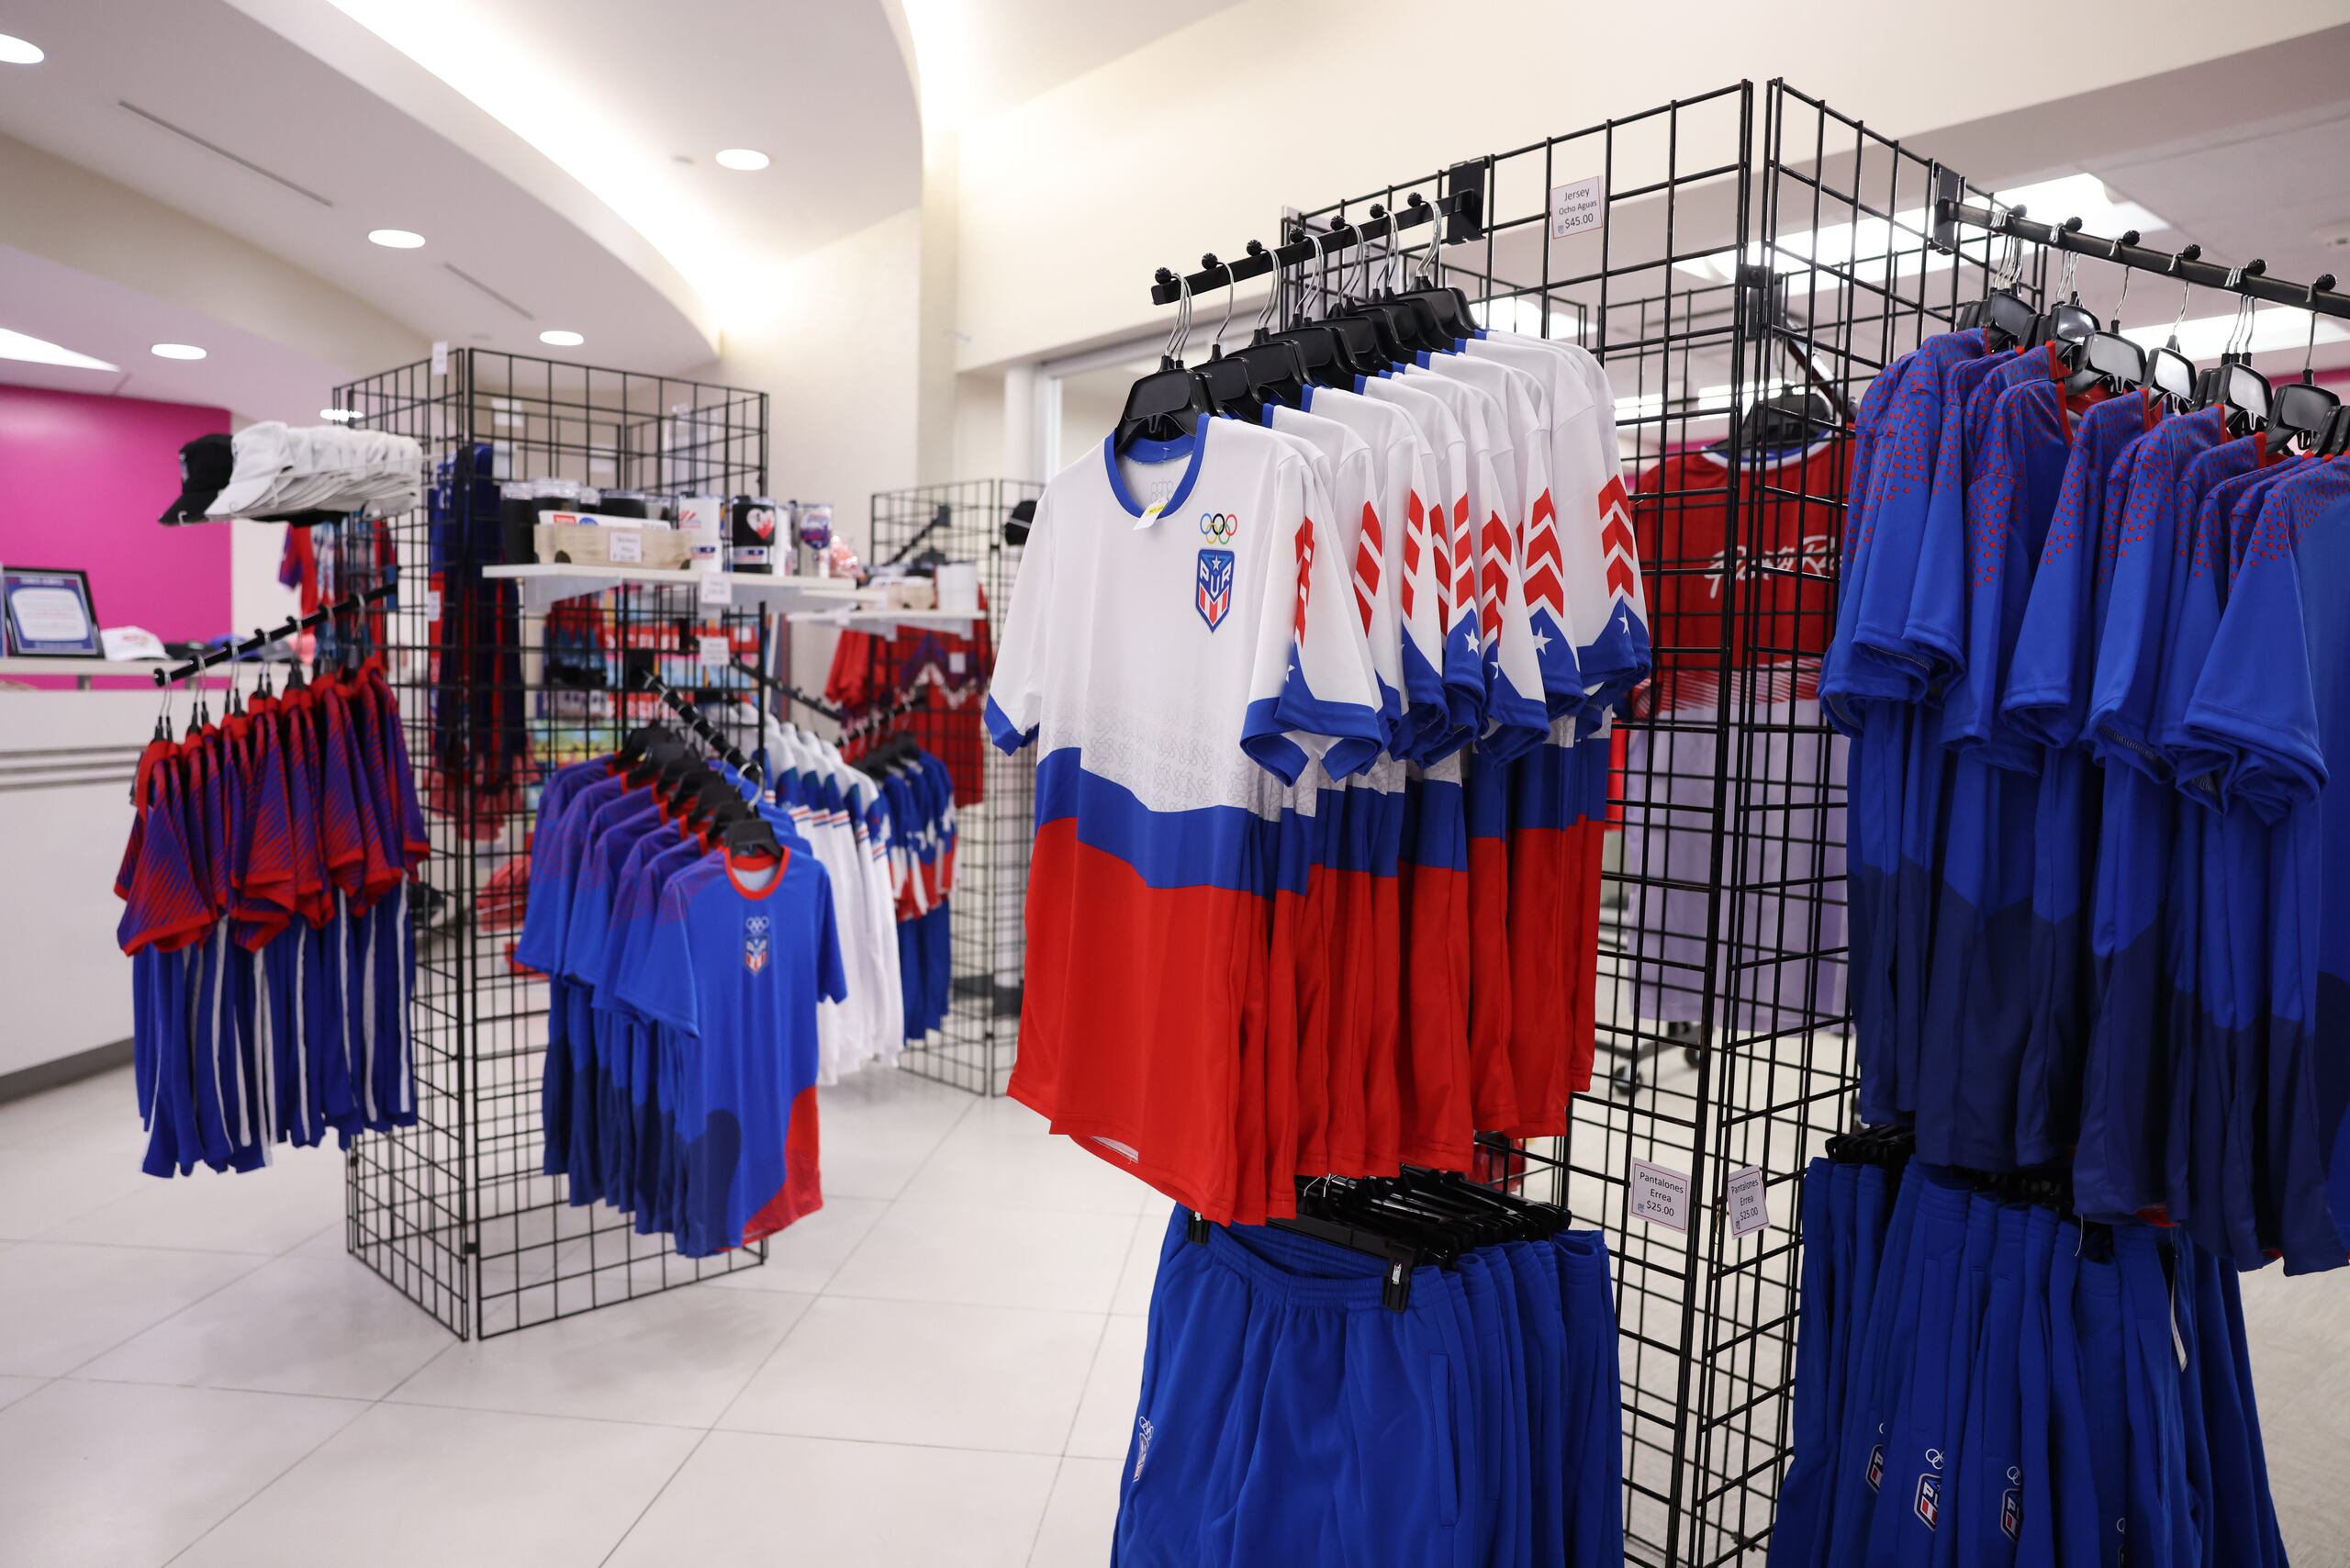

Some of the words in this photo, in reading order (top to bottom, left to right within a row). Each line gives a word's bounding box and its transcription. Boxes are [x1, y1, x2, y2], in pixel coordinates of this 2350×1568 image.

[1564, 188, 1590, 201] Jersey
[1559, 207, 1576, 215] Ocho
[1578, 200, 1597, 211] Aguas
[1565, 213, 1594, 229] $45.00
[1639, 1172, 1684, 1193] Pantalones
[1731, 1180, 1759, 1194] Pantalones
[1650, 1188, 1672, 1203] Errea
[1740, 1195, 1754, 1206] Errea
[1646, 1200, 1674, 1217] $25.00
[1740, 1207, 1759, 1221] $25.00
